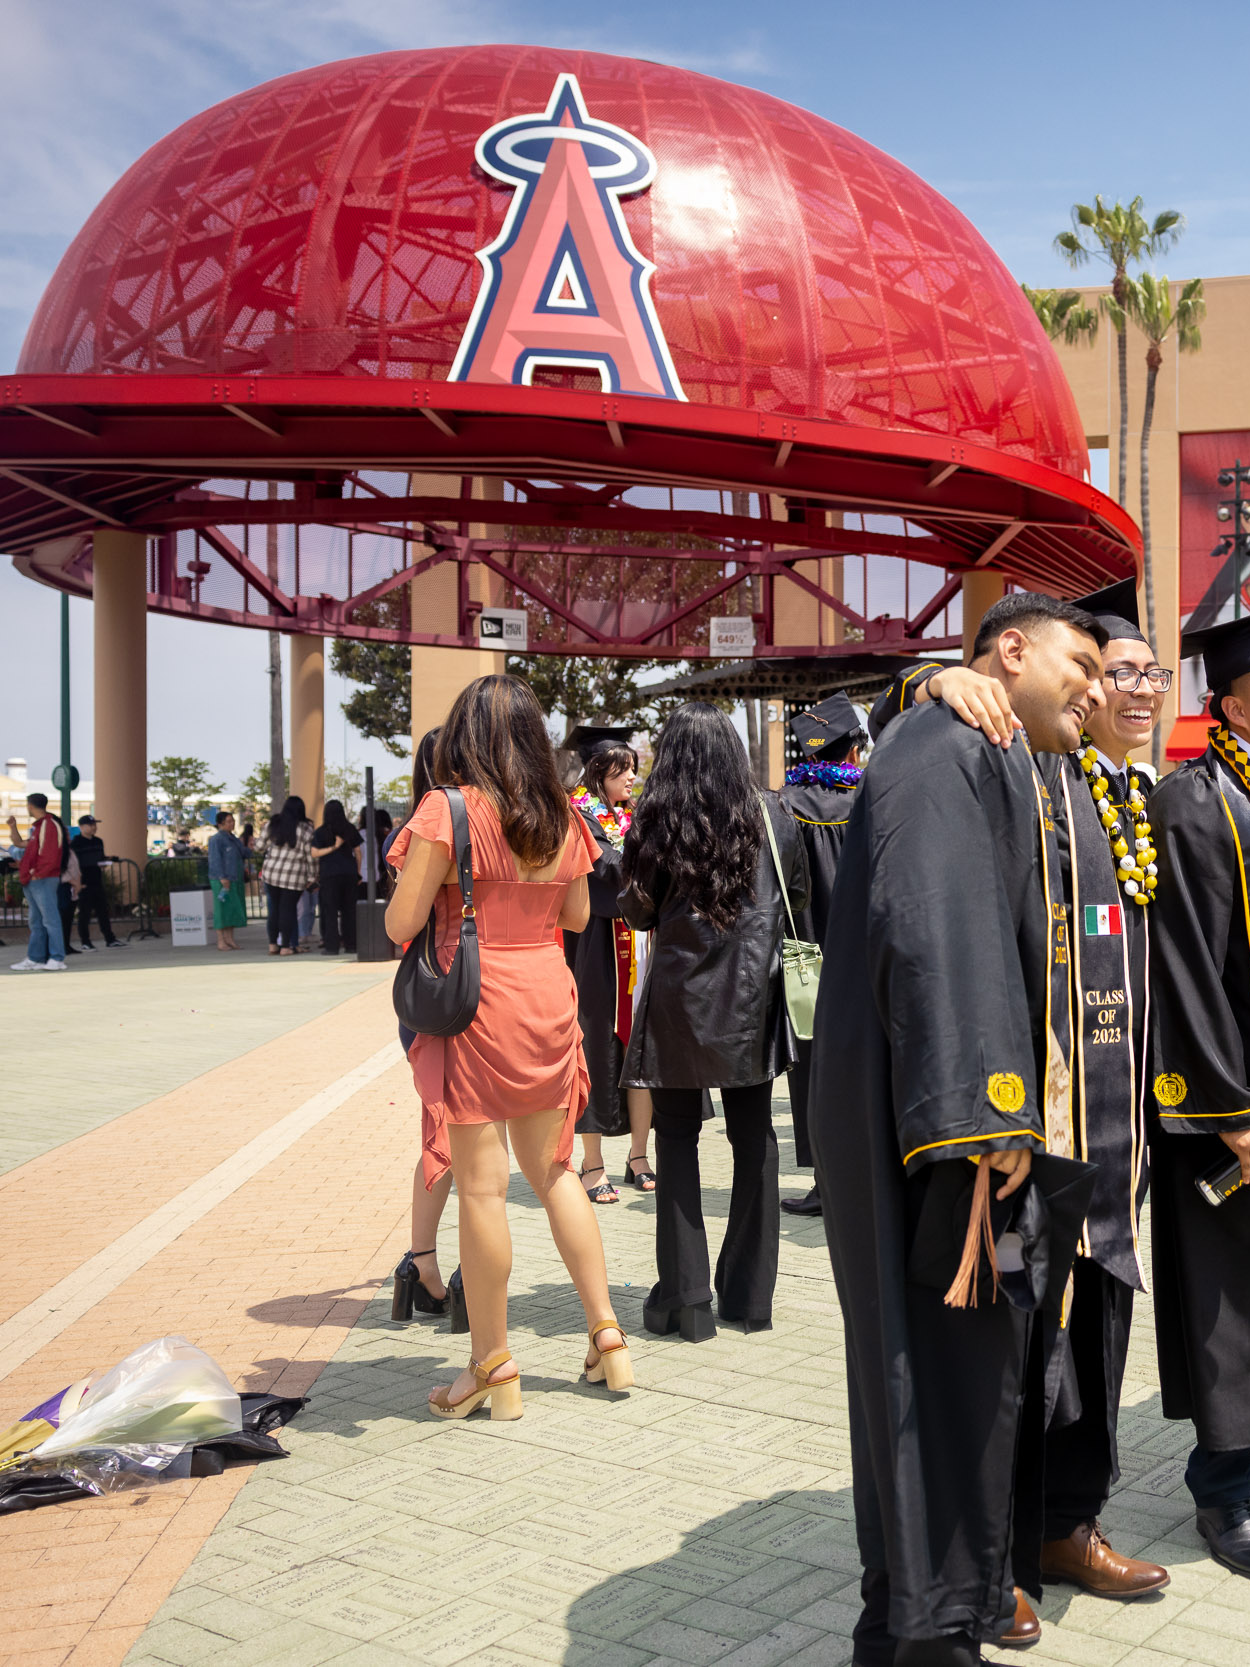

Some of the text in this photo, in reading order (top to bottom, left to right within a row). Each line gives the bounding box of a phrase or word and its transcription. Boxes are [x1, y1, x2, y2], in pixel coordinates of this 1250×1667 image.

[449, 73, 689, 402] A
[1085, 989, 1125, 1006] CLASS
[1097, 1009, 1117, 1025] OF
[1092, 1027, 1122, 1045] 2023
[385, 1624, 426, 1643] TYLER
